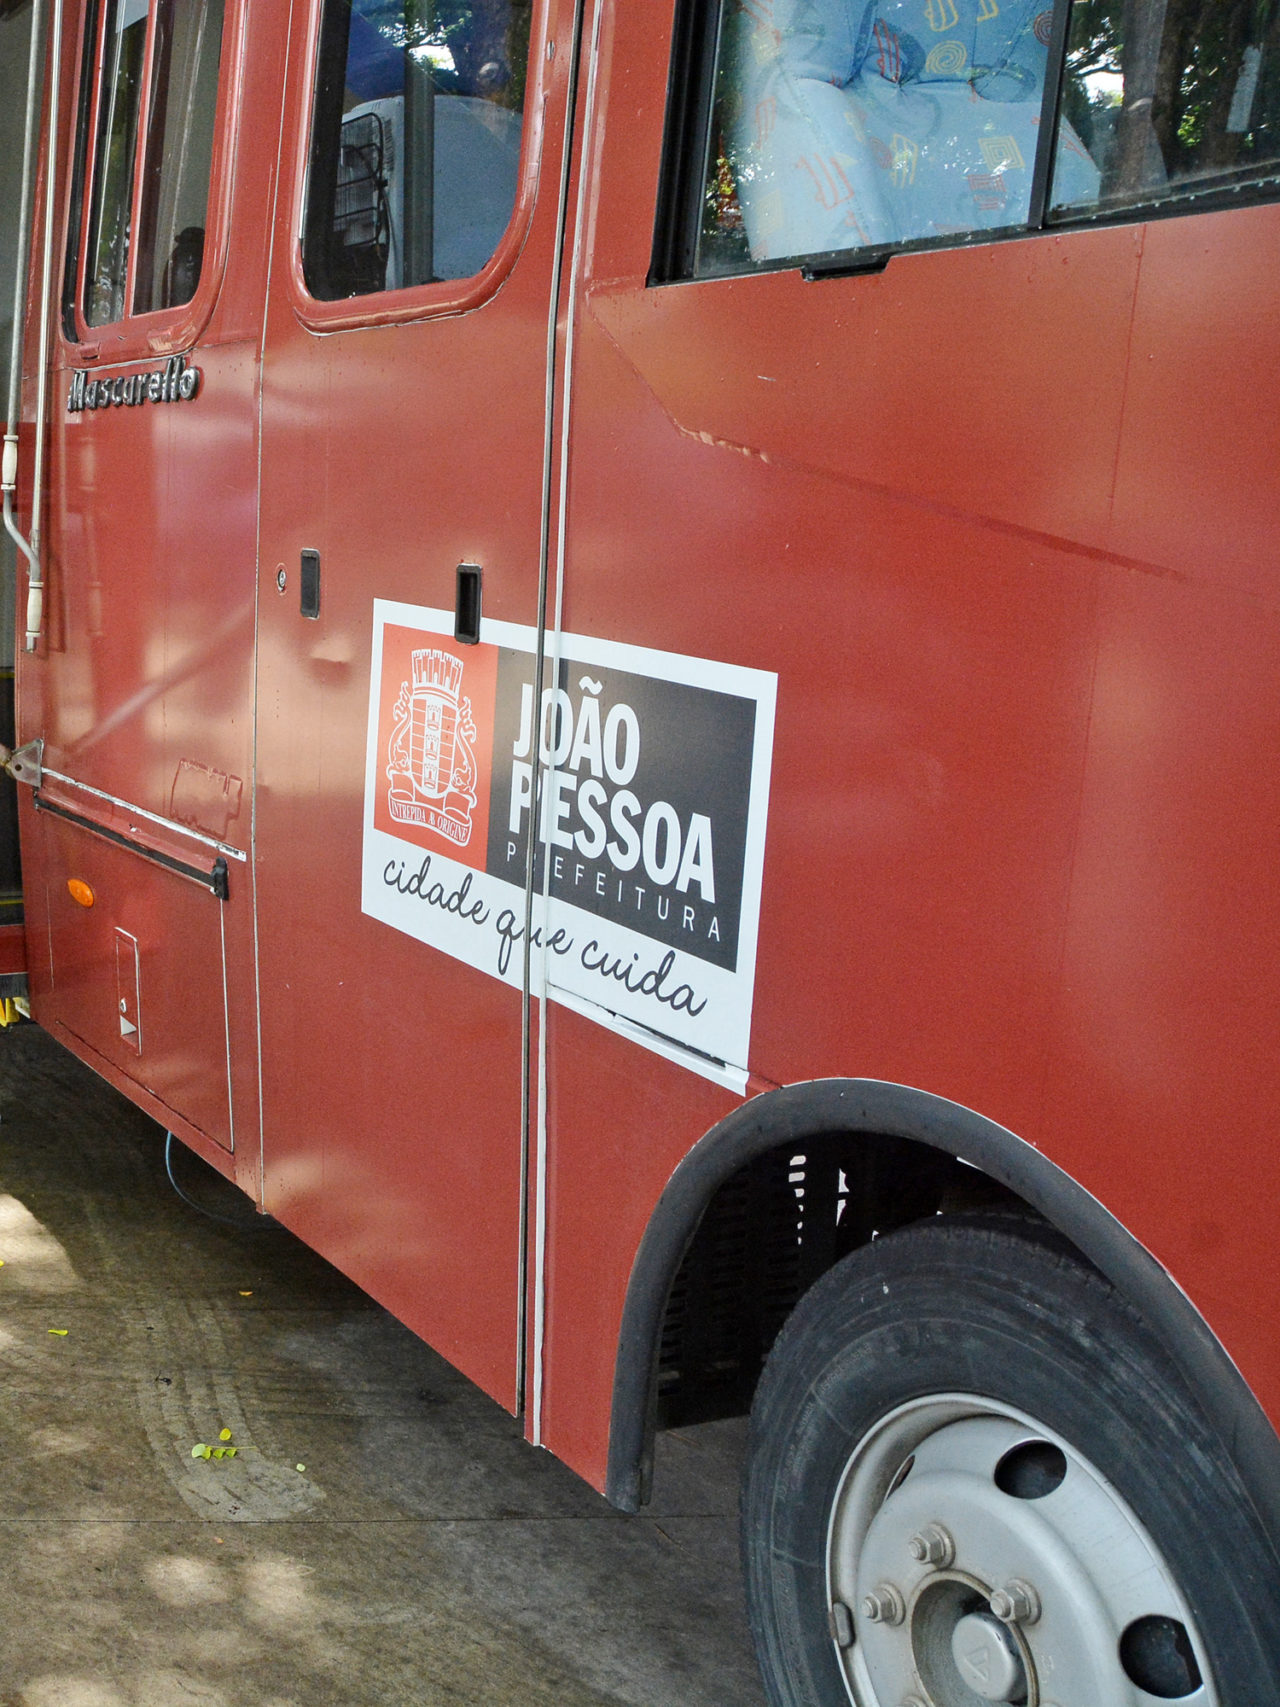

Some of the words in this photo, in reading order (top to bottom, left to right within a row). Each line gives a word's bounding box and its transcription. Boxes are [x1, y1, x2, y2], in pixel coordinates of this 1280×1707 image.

[67, 356, 200, 412] Mascarello
[513, 676, 640, 786] JOÃO
[392, 801, 426, 823] INTREPIDA
[437, 815, 468, 842] ORIGINE
[509, 759, 716, 904] PESSOA
[383, 856, 490, 925] cidade
[496, 909, 574, 975] que
[581, 950, 708, 1017] cuida
[507, 841, 720, 941] PEFEITURA
